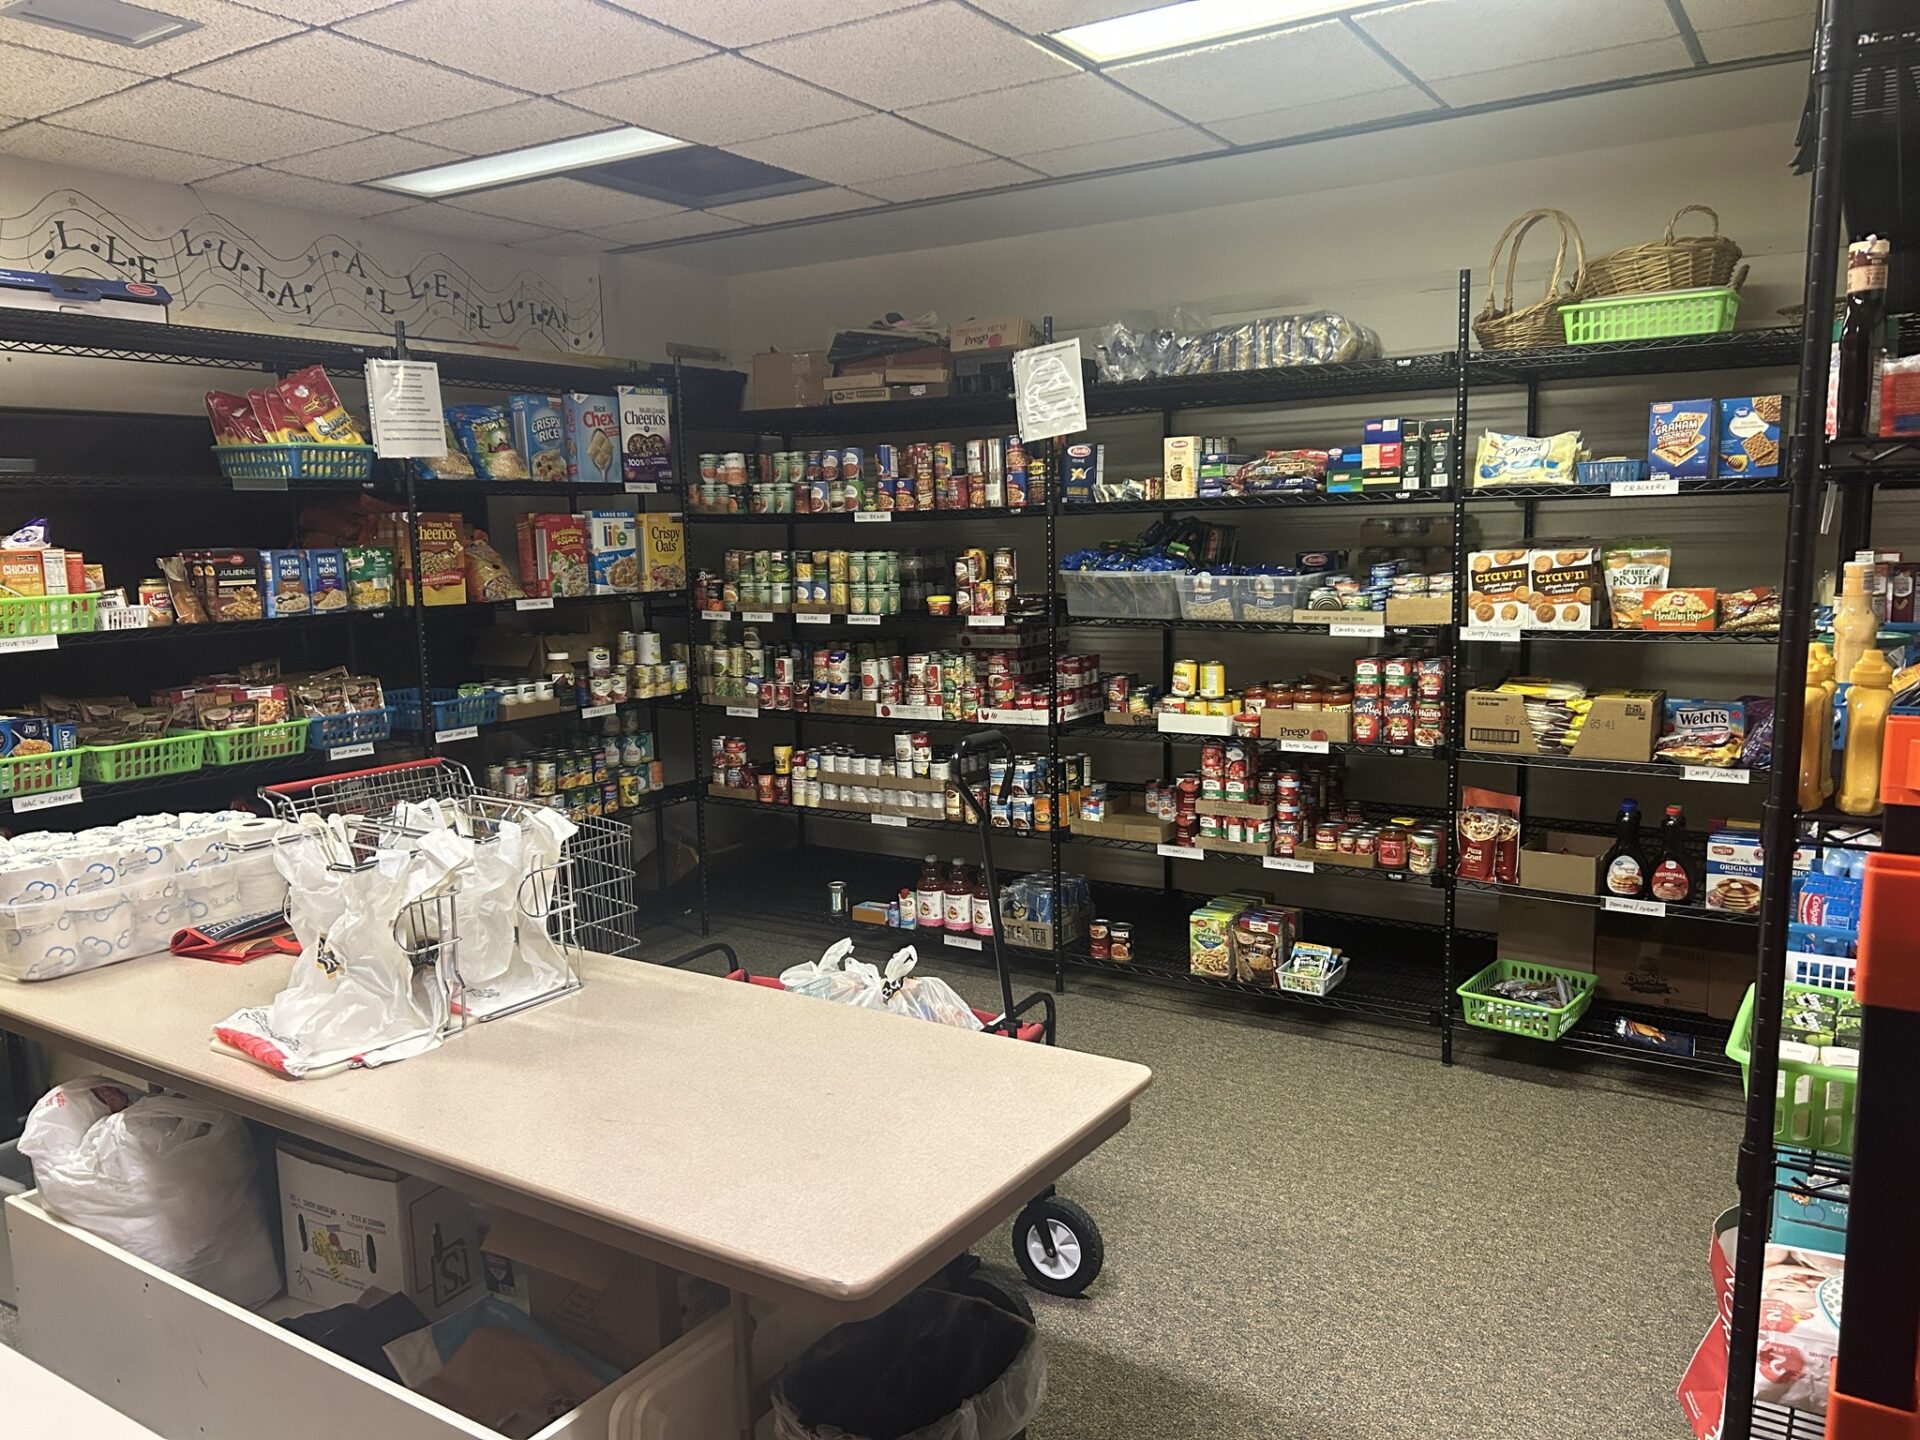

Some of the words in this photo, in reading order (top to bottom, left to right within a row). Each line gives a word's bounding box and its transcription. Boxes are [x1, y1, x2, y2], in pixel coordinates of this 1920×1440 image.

[964, 334, 988, 345] Prego
[583, 411, 615, 428] Chex
[624, 411, 666, 425] Cheerios
[1655, 420, 1698, 435] GRAHAM
[540, 428, 560, 442] RICE
[419, 526, 456, 540] heerios
[603, 524, 627, 547] life
[652, 527, 680, 542] Crispy
[655, 540, 676, 552] Oats
[3, 564, 38, 576] CHICKEN
[1613, 575, 1660, 586] PROTEIN
[1654, 610, 1686, 622] Healthy
[1687, 610, 1702, 621] Pop
[1679, 711, 1728, 725] Welch's
[1280, 727, 1309, 741] Prego
[1655, 872, 1686, 880] ORIGINAL
[1720, 864, 1758, 874] ORIGINAL
